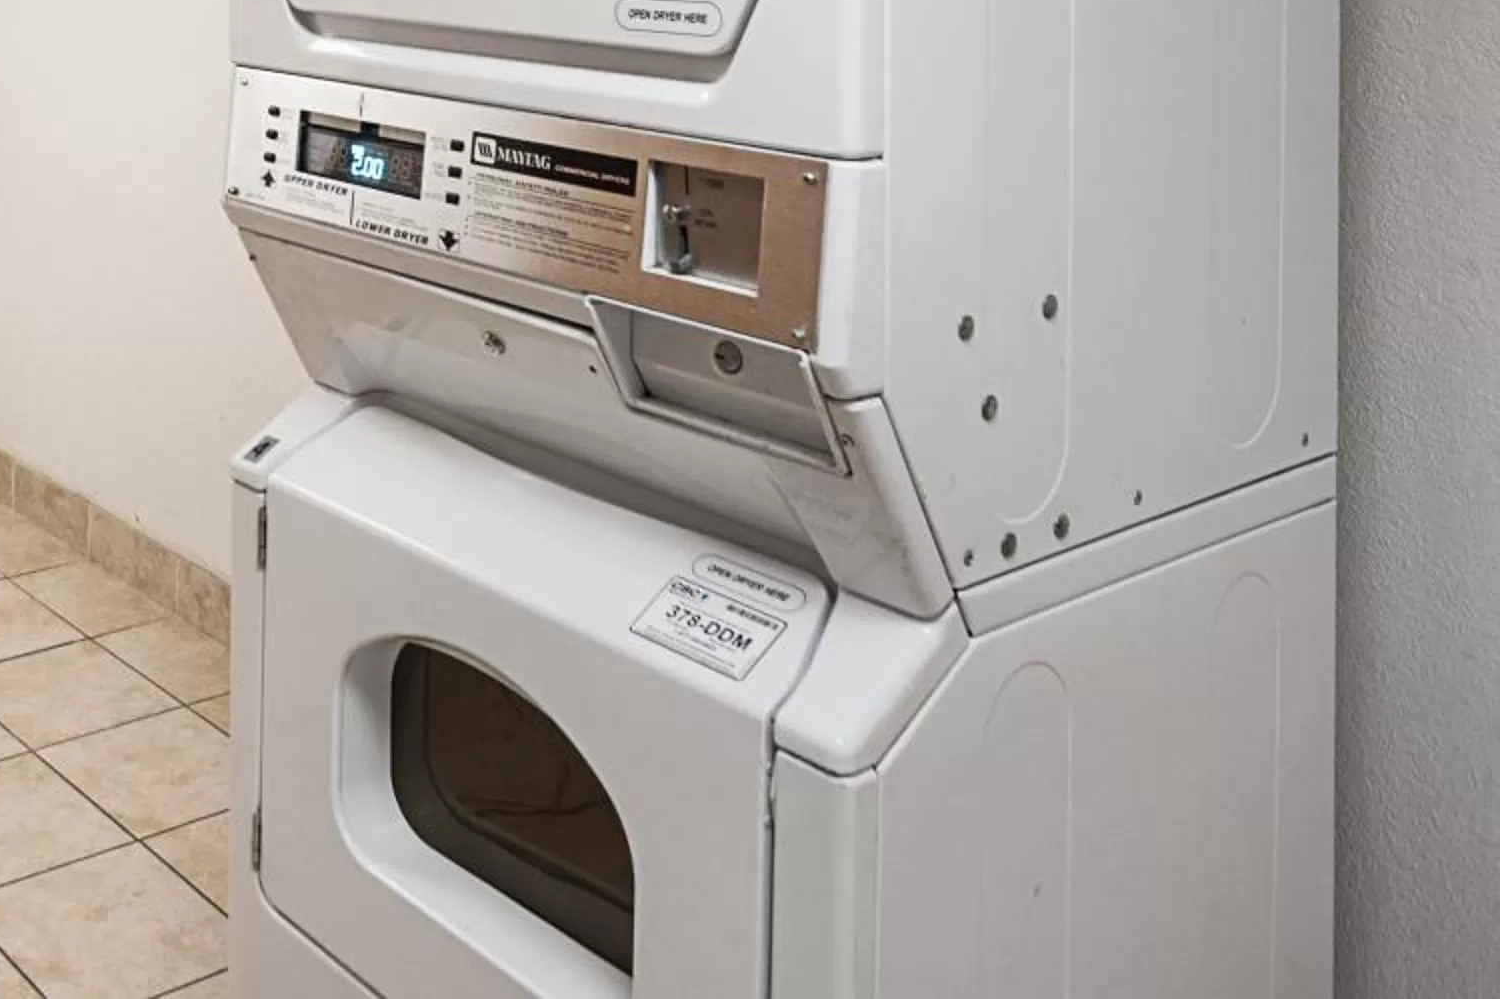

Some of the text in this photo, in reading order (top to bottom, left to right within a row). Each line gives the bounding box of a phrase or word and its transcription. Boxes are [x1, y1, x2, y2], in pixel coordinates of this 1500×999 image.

[628, 8, 706, 24] OPEN DRYER HERE
[497, 146, 551, 170] MAYTAG
[284, 173, 349, 196] UPPER DRYER
[355, 218, 429, 245] LOWER DRYER
[666, 603, 753, 651] 378-DDM
